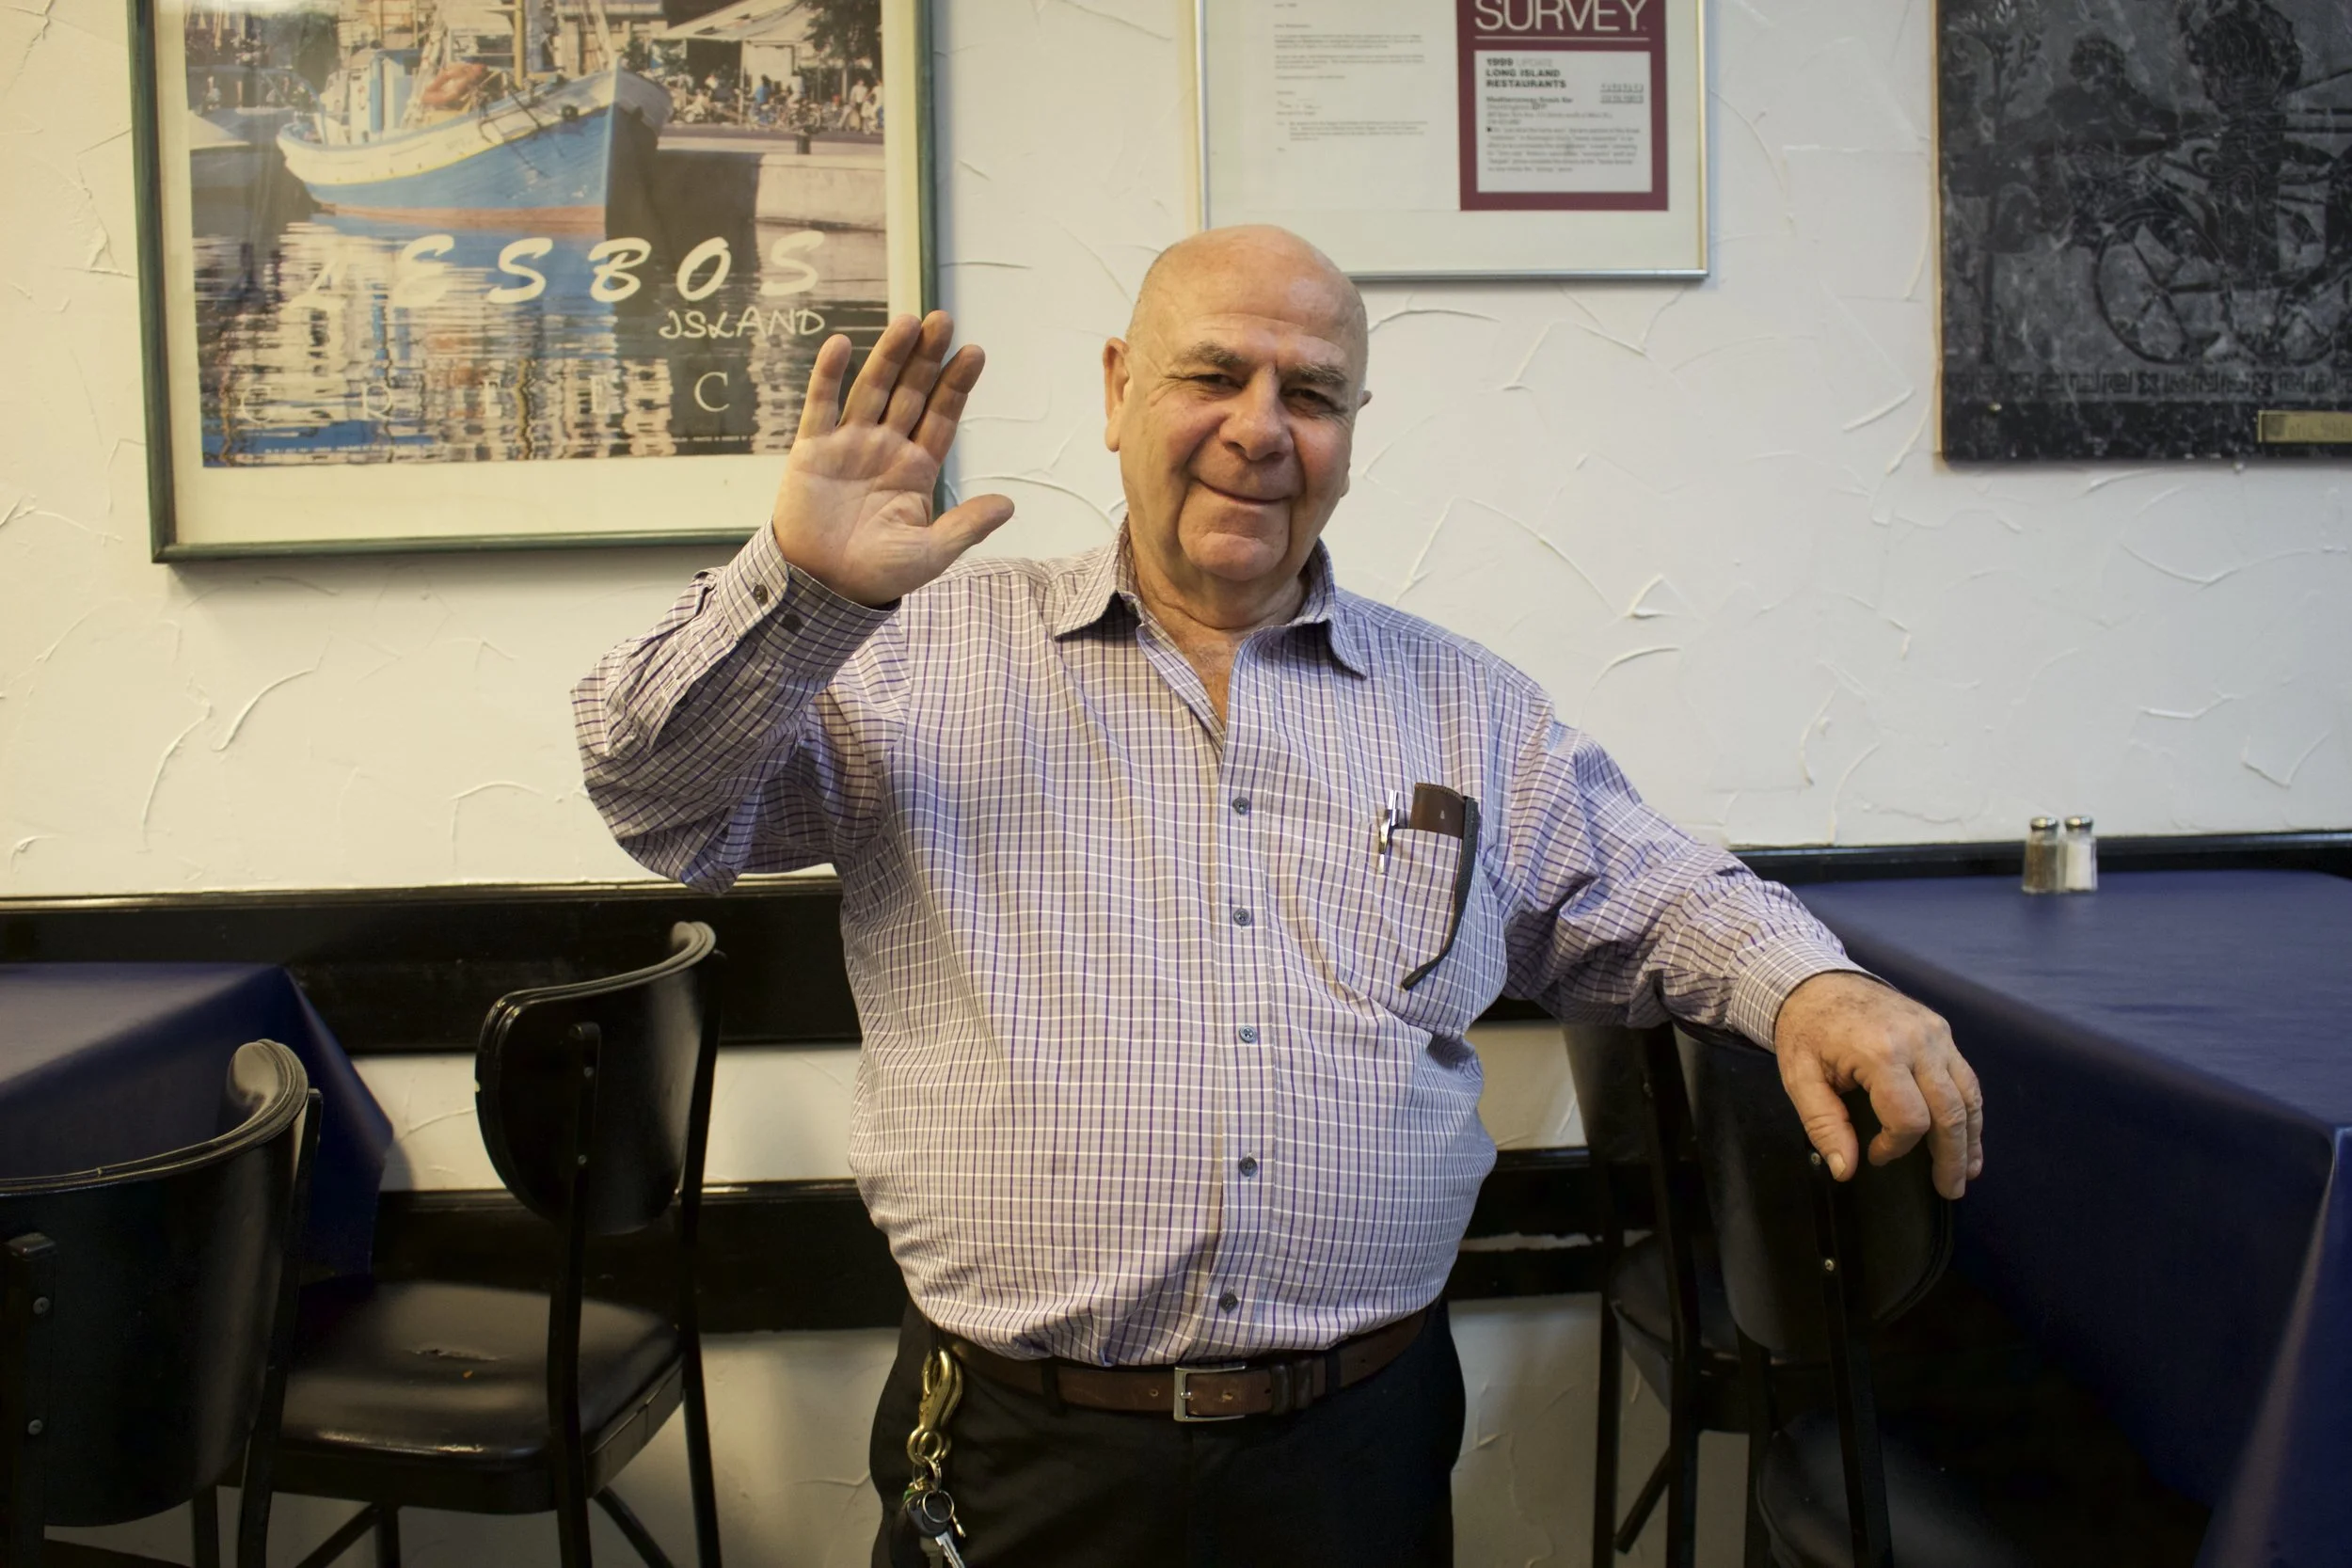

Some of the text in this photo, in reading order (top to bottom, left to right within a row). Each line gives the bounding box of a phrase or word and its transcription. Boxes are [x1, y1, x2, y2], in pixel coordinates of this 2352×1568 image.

[1475, 0, 1646, 31] SURVEY
[1486, 69, 1561, 77] LONG ISLAND
[1486, 79, 1566, 88] RESTAURANTS
[287, 231, 825, 310] LESBOS
[660, 306, 825, 340] ISLAND
[241, 371, 732, 423] GREEC
